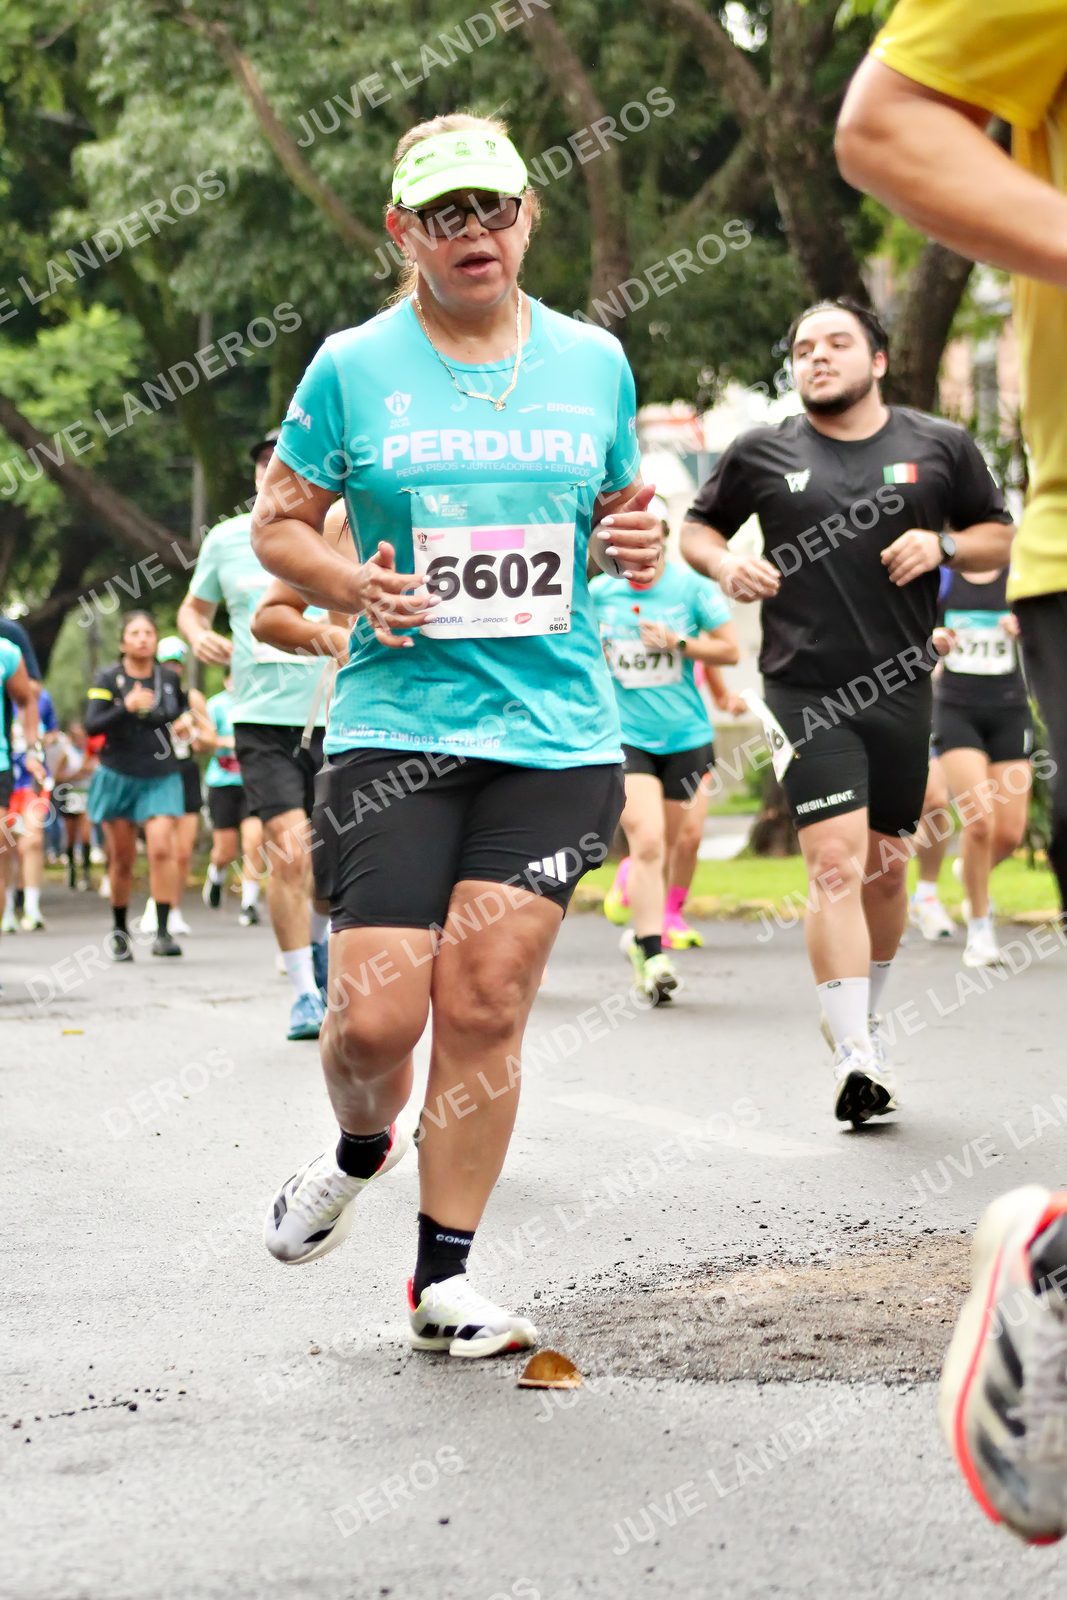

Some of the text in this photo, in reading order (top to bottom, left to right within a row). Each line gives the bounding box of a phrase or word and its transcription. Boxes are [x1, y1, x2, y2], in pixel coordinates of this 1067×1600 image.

[546, 402, 596, 417] BROOKS
[382, 428, 599, 471] PERDURA
[396, 461, 590, 479] PEGA PISOS JUNTEADORES ESTUCOS
[425, 551, 562, 601] 6602
[429, 616, 464, 624] RDURA
[549, 623, 568, 631] 6602
